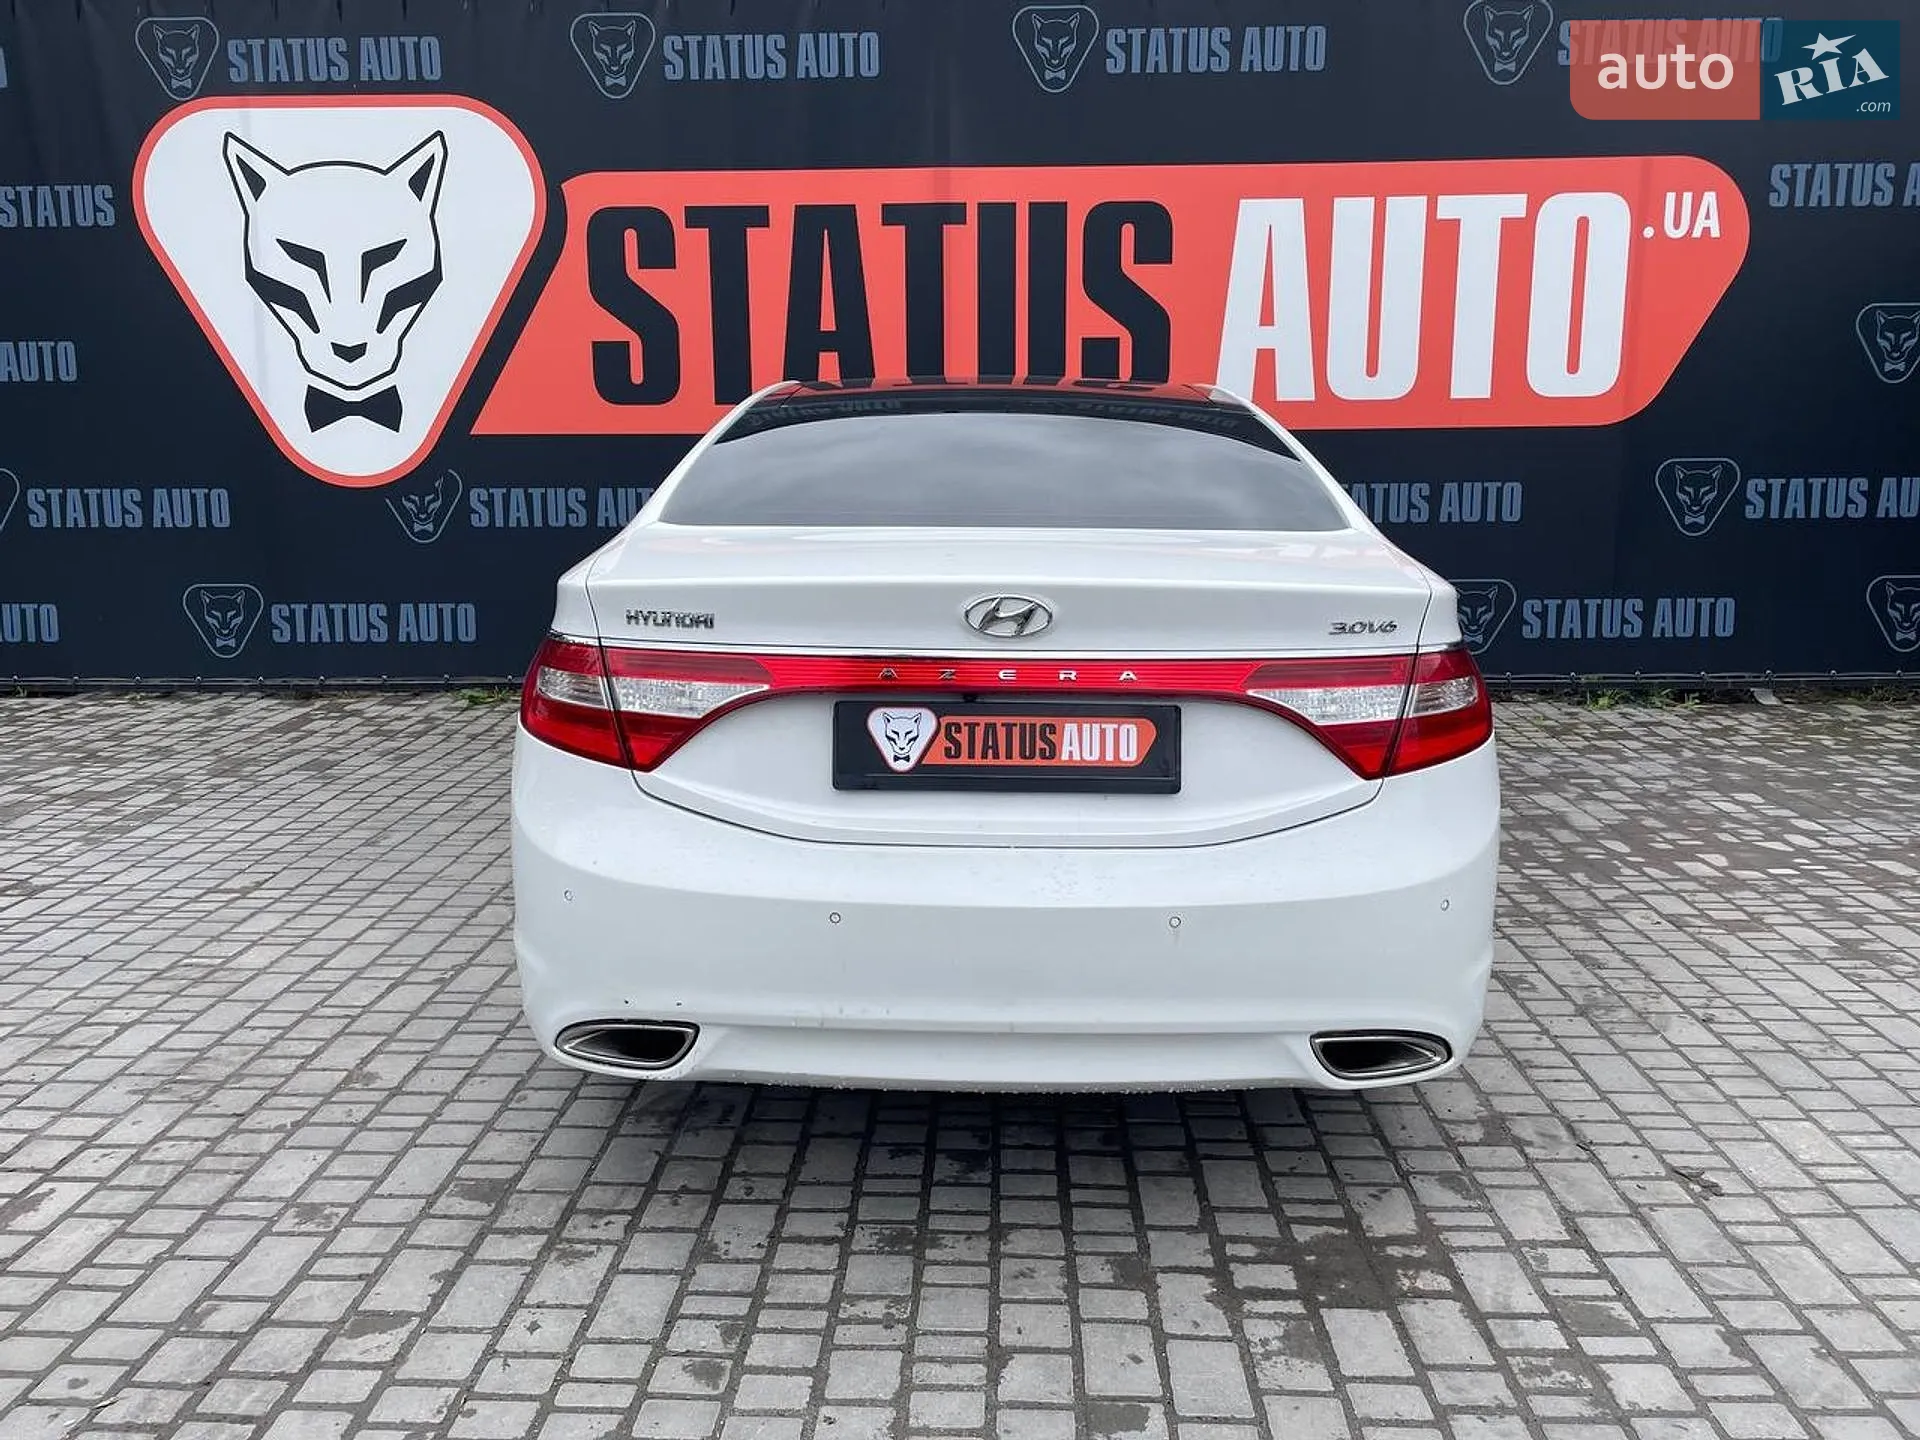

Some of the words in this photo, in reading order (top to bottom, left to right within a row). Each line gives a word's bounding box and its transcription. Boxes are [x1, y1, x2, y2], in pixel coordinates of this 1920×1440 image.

[228, 37, 349, 83] STATUS
[359, 35, 442, 82] AUTO
[663, 33, 786, 81] STATUS
[797, 31, 880, 79] AUTO
[1106, 26, 1231, 74] STATUS
[1241, 25, 1326, 72] AUTO
[1769, 162, 1896, 207] STATUS
[0, 184, 116, 228] STATUS
[0, 341, 78, 382] AUTO
[27, 488, 143, 528] STATUS
[152, 488, 231, 528] AUTO
[469, 488, 588, 528] STATUS
[1439, 482, 1523, 522] AUTO
[1745, 477, 1868, 519] STATUS
[1877, 477, 1920, 518] AU
[0, 603, 60, 642] UTO
[270, 603, 389, 644] STATUS
[398, 603, 477, 643] AUTO
[626, 608, 715, 629] HYUNDAI
[1522, 598, 1643, 639] STATUS
[1651, 597, 1735, 638] AUTO
[879, 667, 1138, 682] AZERA
